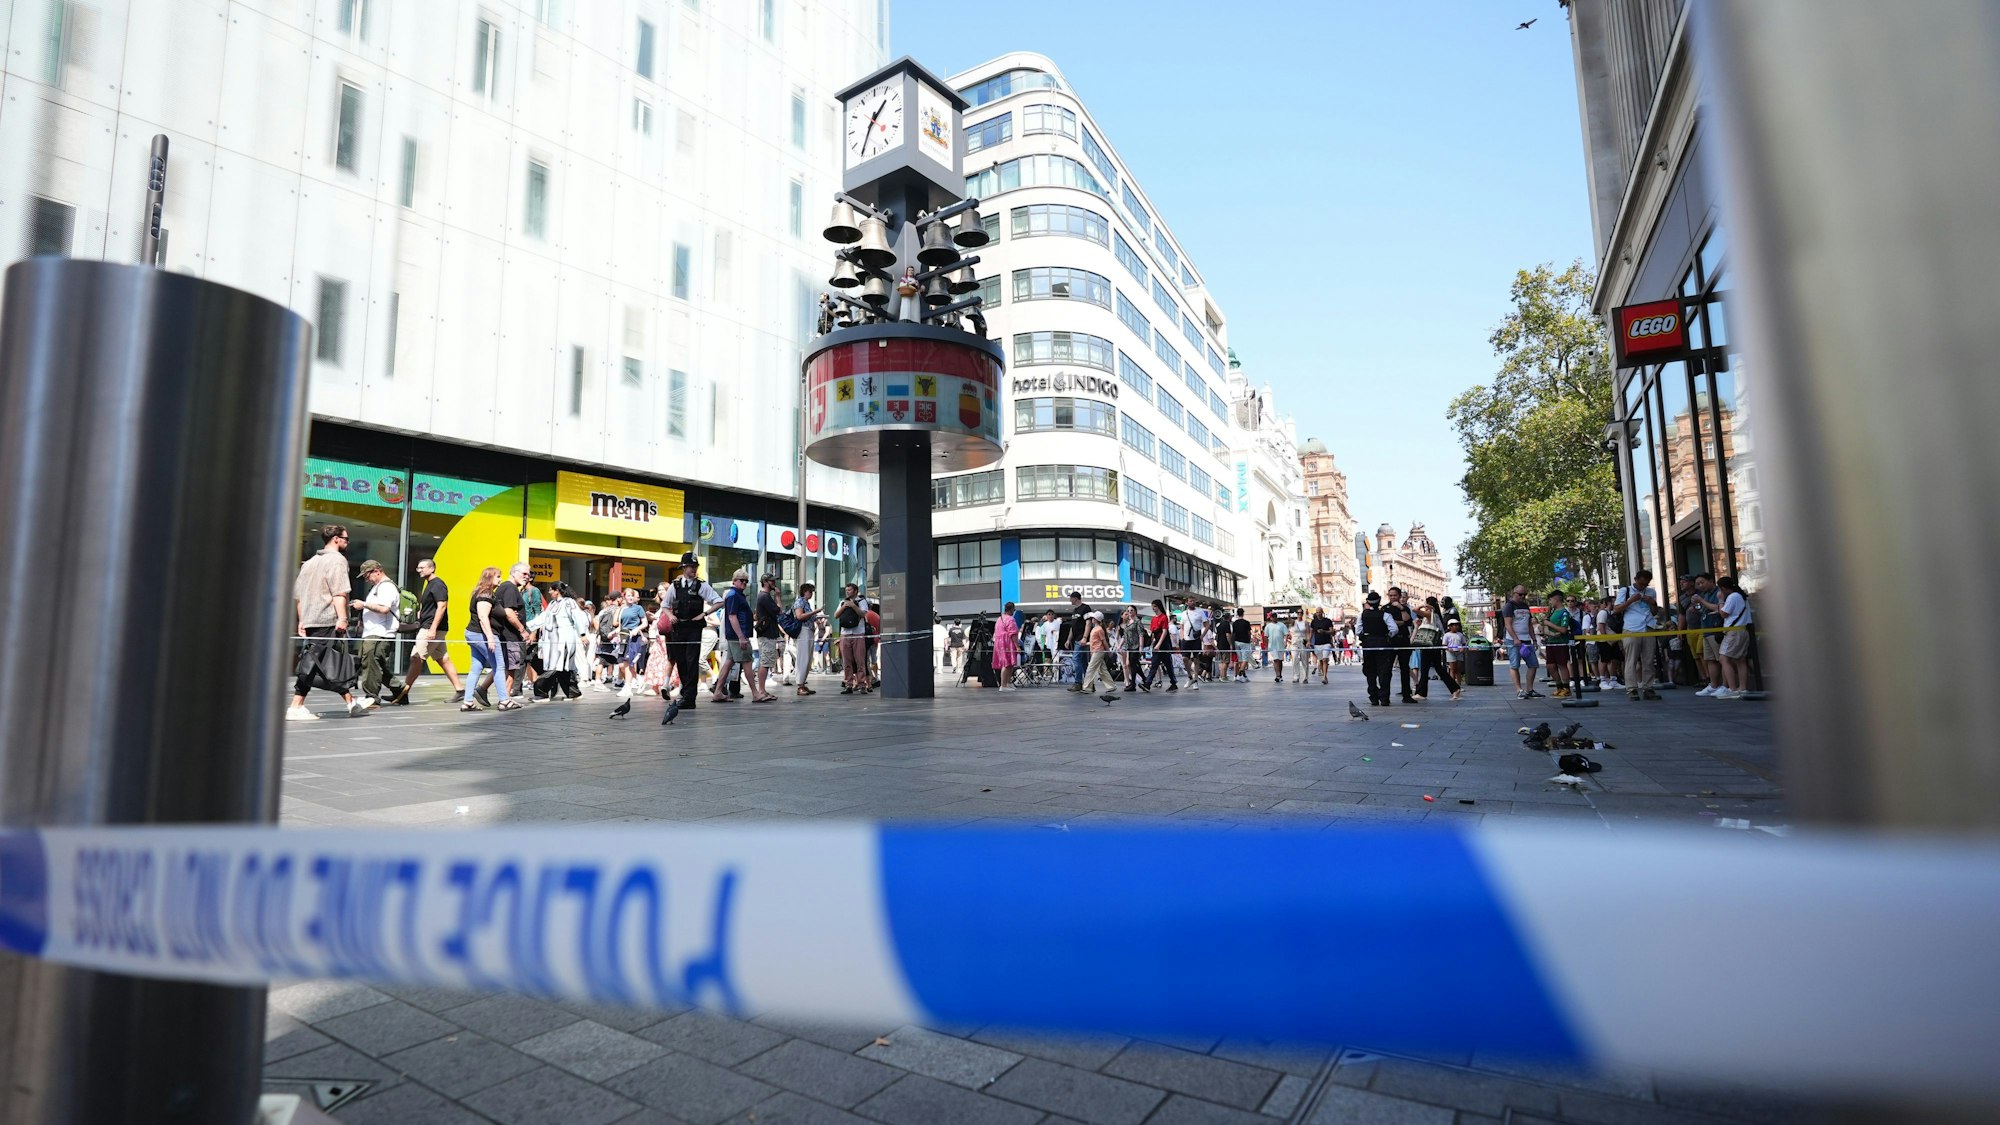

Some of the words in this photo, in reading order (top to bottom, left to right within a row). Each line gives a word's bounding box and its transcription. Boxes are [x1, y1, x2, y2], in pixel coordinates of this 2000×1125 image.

[1628, 314, 1678, 338] LEGO
[1012, 374, 1050, 393] hotel
[1068, 374, 1118, 399] INDIGO
[414, 481, 463, 505] for
[1236, 462, 1249, 513] IMAX
[1061, 585, 1124, 599] GREGGS
[71, 847, 154, 956] CROSS
[305, 856, 420, 978] LINE
[441, 860, 744, 1012] POLICE
